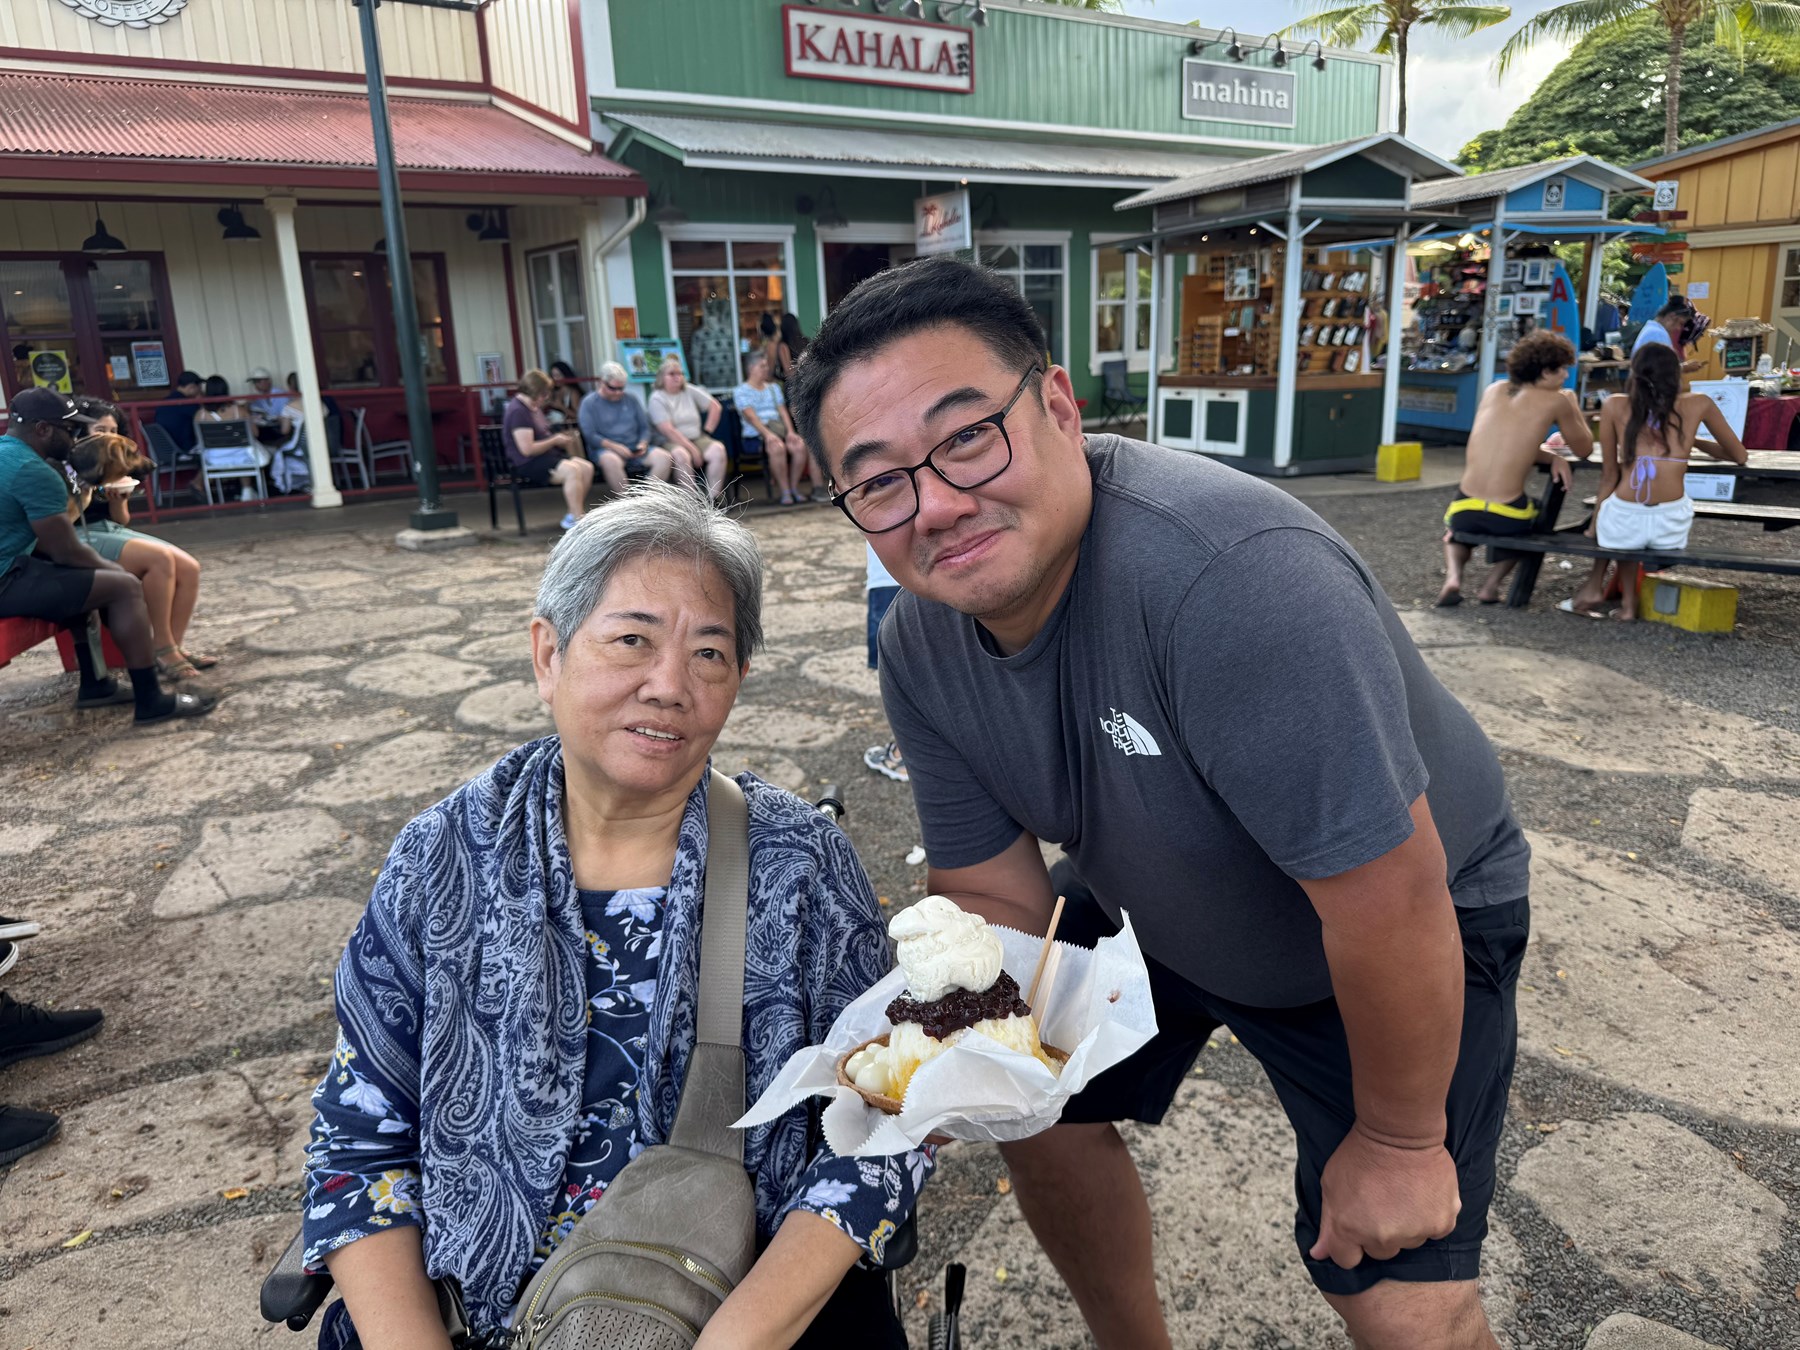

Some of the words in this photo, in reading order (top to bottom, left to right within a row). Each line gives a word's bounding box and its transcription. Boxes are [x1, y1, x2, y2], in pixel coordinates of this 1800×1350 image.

[84, 0, 159, 17] OFFEE
[797, 23, 957, 76] KAHALA
[1191, 78, 1289, 109] mahina
